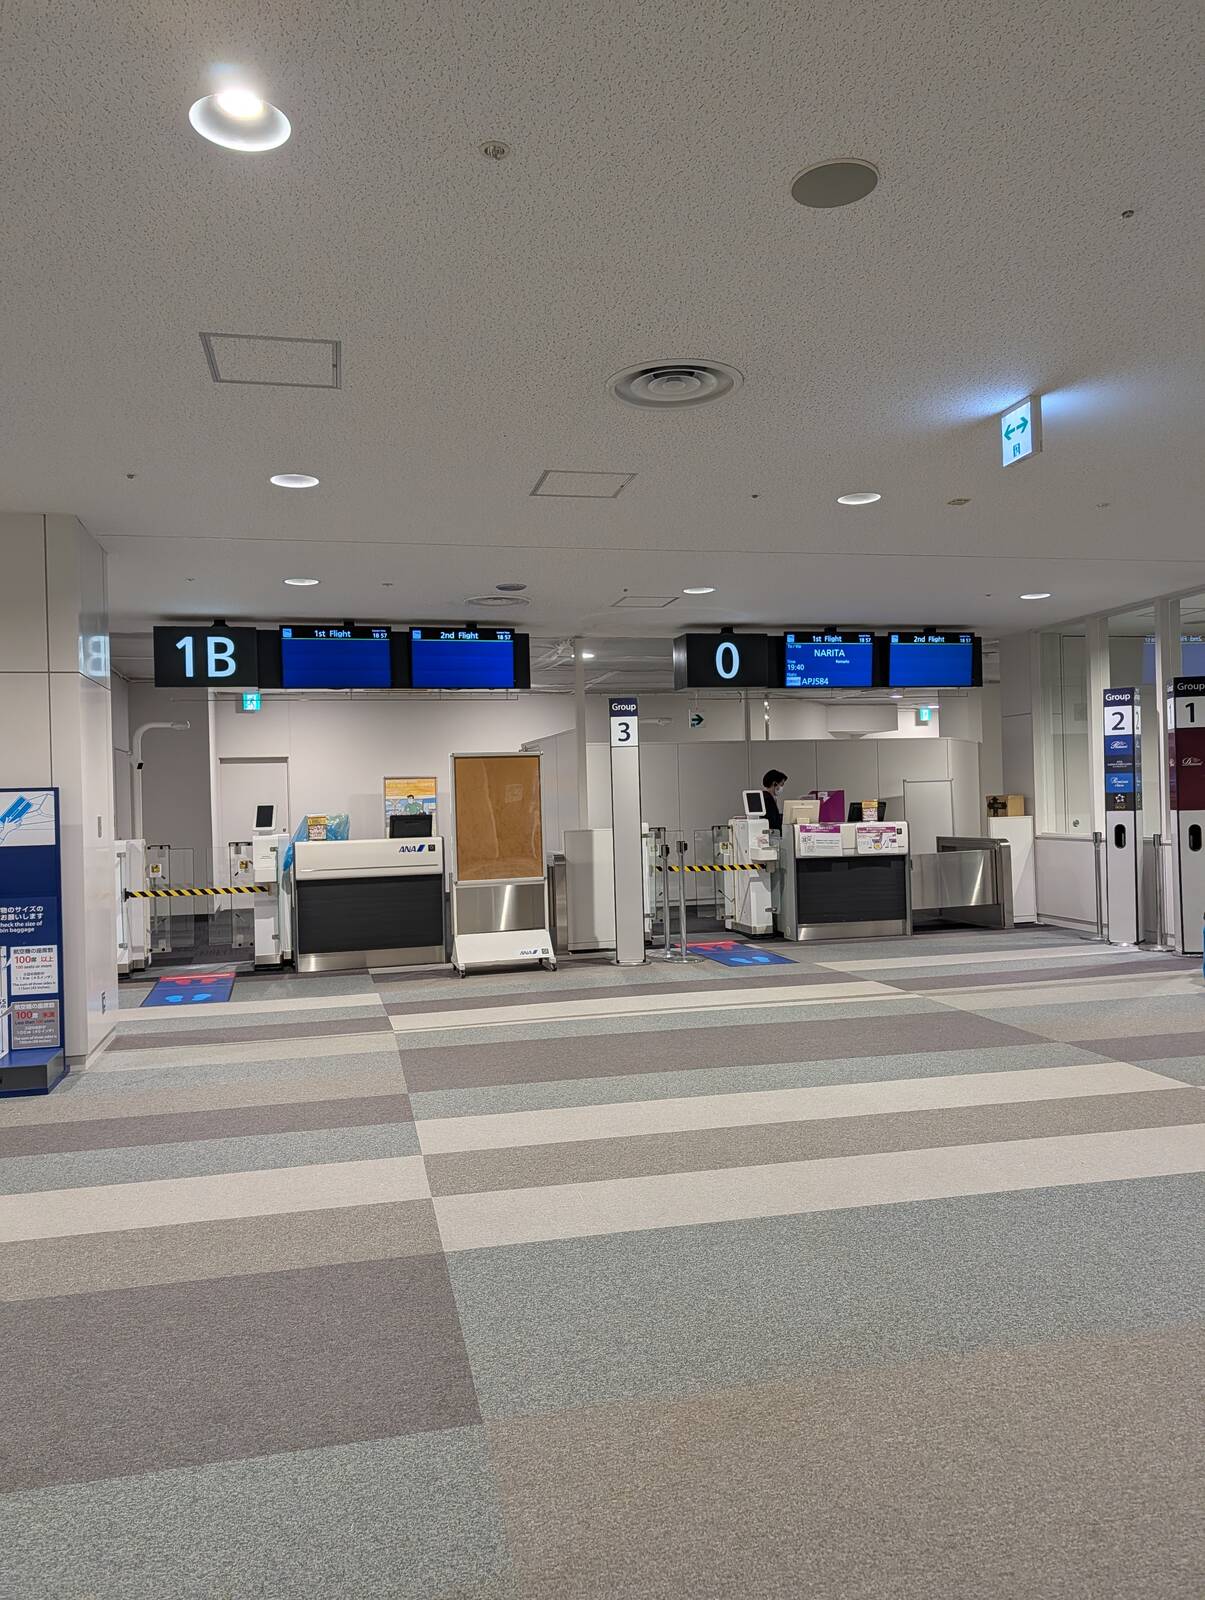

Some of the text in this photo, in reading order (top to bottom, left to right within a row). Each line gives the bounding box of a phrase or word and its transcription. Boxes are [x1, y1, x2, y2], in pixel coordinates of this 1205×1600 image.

[330, 630, 351, 638] Flight
[458, 632, 479, 640] Flight
[176, 636, 236, 678] 1B
[716, 642, 739, 679] 0
[1177, 682, 1205, 692] Group
[1105, 693, 1130, 701] Group
[612, 703, 636, 712] Group
[1185, 703, 1195, 723] 1
[1112, 712, 1125, 731] 2
[618, 722, 631, 742] 3
